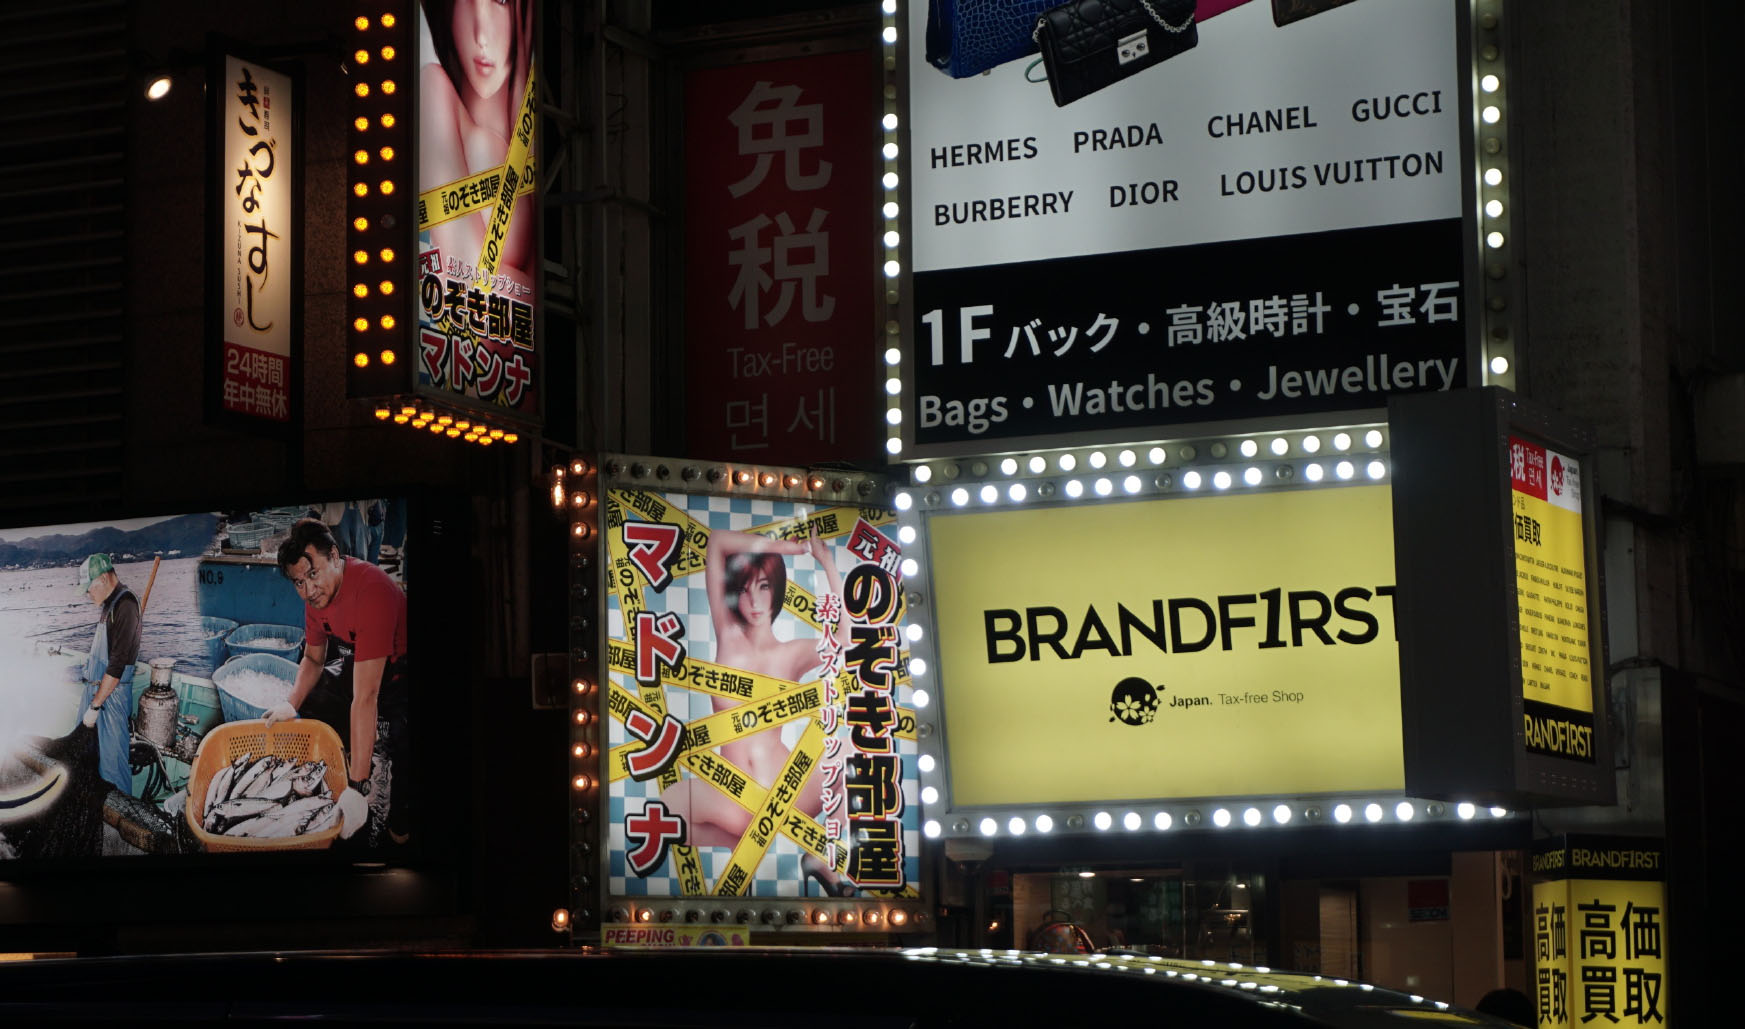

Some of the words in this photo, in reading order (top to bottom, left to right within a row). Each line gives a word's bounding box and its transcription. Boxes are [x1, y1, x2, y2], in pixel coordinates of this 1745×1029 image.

[930, 136, 1039, 169] HERMES
[1073, 122, 1164, 154] PRADA
[1207, 105, 1318, 139] CHANEL
[1351, 90, 1443, 123] GUCCI
[236, 67, 280, 330] きづなすし
[727, 81, 837, 330] 免税
[934, 190, 1075, 227] BURBERRY
[1109, 179, 1179, 209] DIOR
[1220, 164, 1307, 197] LOUIS
[1313, 150, 1444, 187] VUITTON
[420, 272, 535, 352] のぞき部屋
[921, 304, 994, 367] 1F
[226, 348, 284, 387] 24時間
[419, 327, 532, 407] マドンナ
[727, 343, 835, 379] Tax-Free
[223, 378, 288, 419] 年中無休
[919, 394, 1009, 435] Bags
[1047, 372, 1215, 418] Watches
[1256, 353, 1459, 401] Jewellery
[854, 529, 902, 579] 元祖
[622, 521, 687, 879] マドンナ
[741, 687, 822, 729] のぞき部屋
[842, 561, 906, 890] のぞき部屋
[1168, 692, 1214, 709] Japan.
[1217, 691, 1269, 706] Tax-free
[1271, 689, 1305, 706] Shop
[816, 593, 843, 872] 素人ストリップショー
[757, 749, 814, 838] のぞき部屋
[604, 929, 676, 945] PEEPING
[1535, 901, 1567, 962] 高価
[1577, 898, 1662, 960] 高価
[1537, 967, 1568, 1025] 買取
[1579, 965, 1664, 1025] 買取
